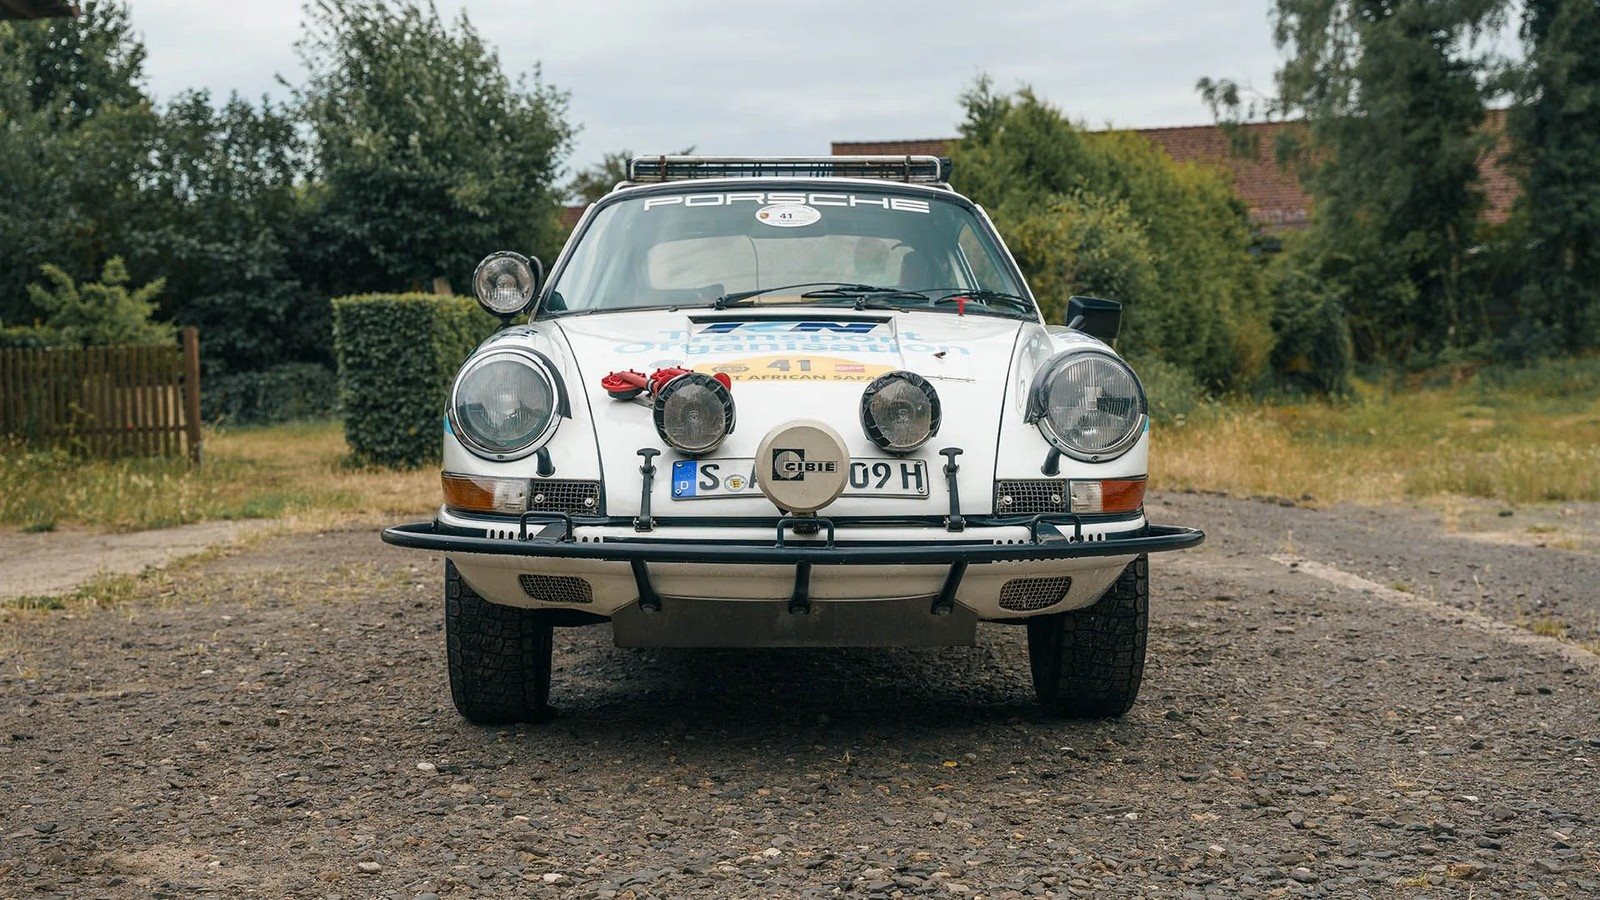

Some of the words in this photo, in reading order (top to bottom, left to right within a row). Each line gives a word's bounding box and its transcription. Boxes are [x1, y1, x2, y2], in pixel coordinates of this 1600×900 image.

[643, 192, 931, 214] PORSCHE
[779, 212, 793, 220] 41
[657, 330, 922, 343] Transport
[613, 340, 971, 356] Organisation
[766, 358, 812, 373] 41
[750, 373, 827, 381] AFRICAN
[832, 374, 876, 382] SAFA
[699, 463, 720, 491] S
[680, 480, 689, 490] D
